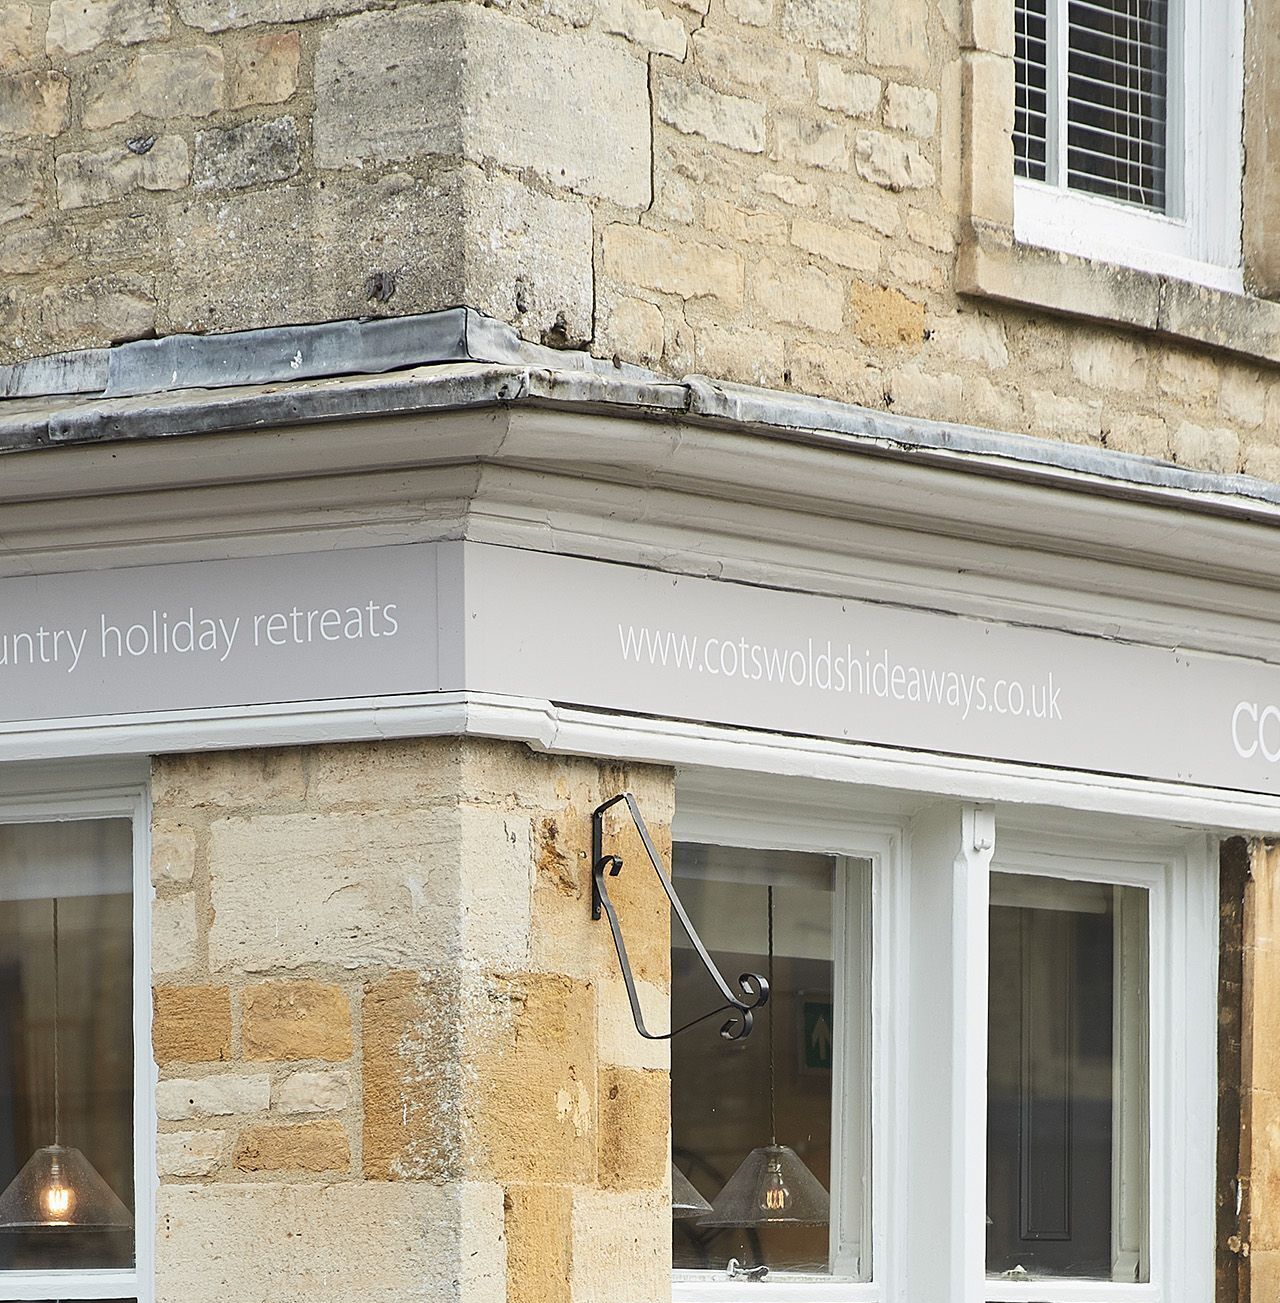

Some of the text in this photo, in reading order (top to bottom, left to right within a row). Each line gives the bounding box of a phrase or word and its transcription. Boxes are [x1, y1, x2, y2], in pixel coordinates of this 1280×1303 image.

[101, 609, 240, 662] holiday
[254, 600, 399, 646] retreats
[618, 623, 1063, 720] www.cotswoldshideaways.co.uk
